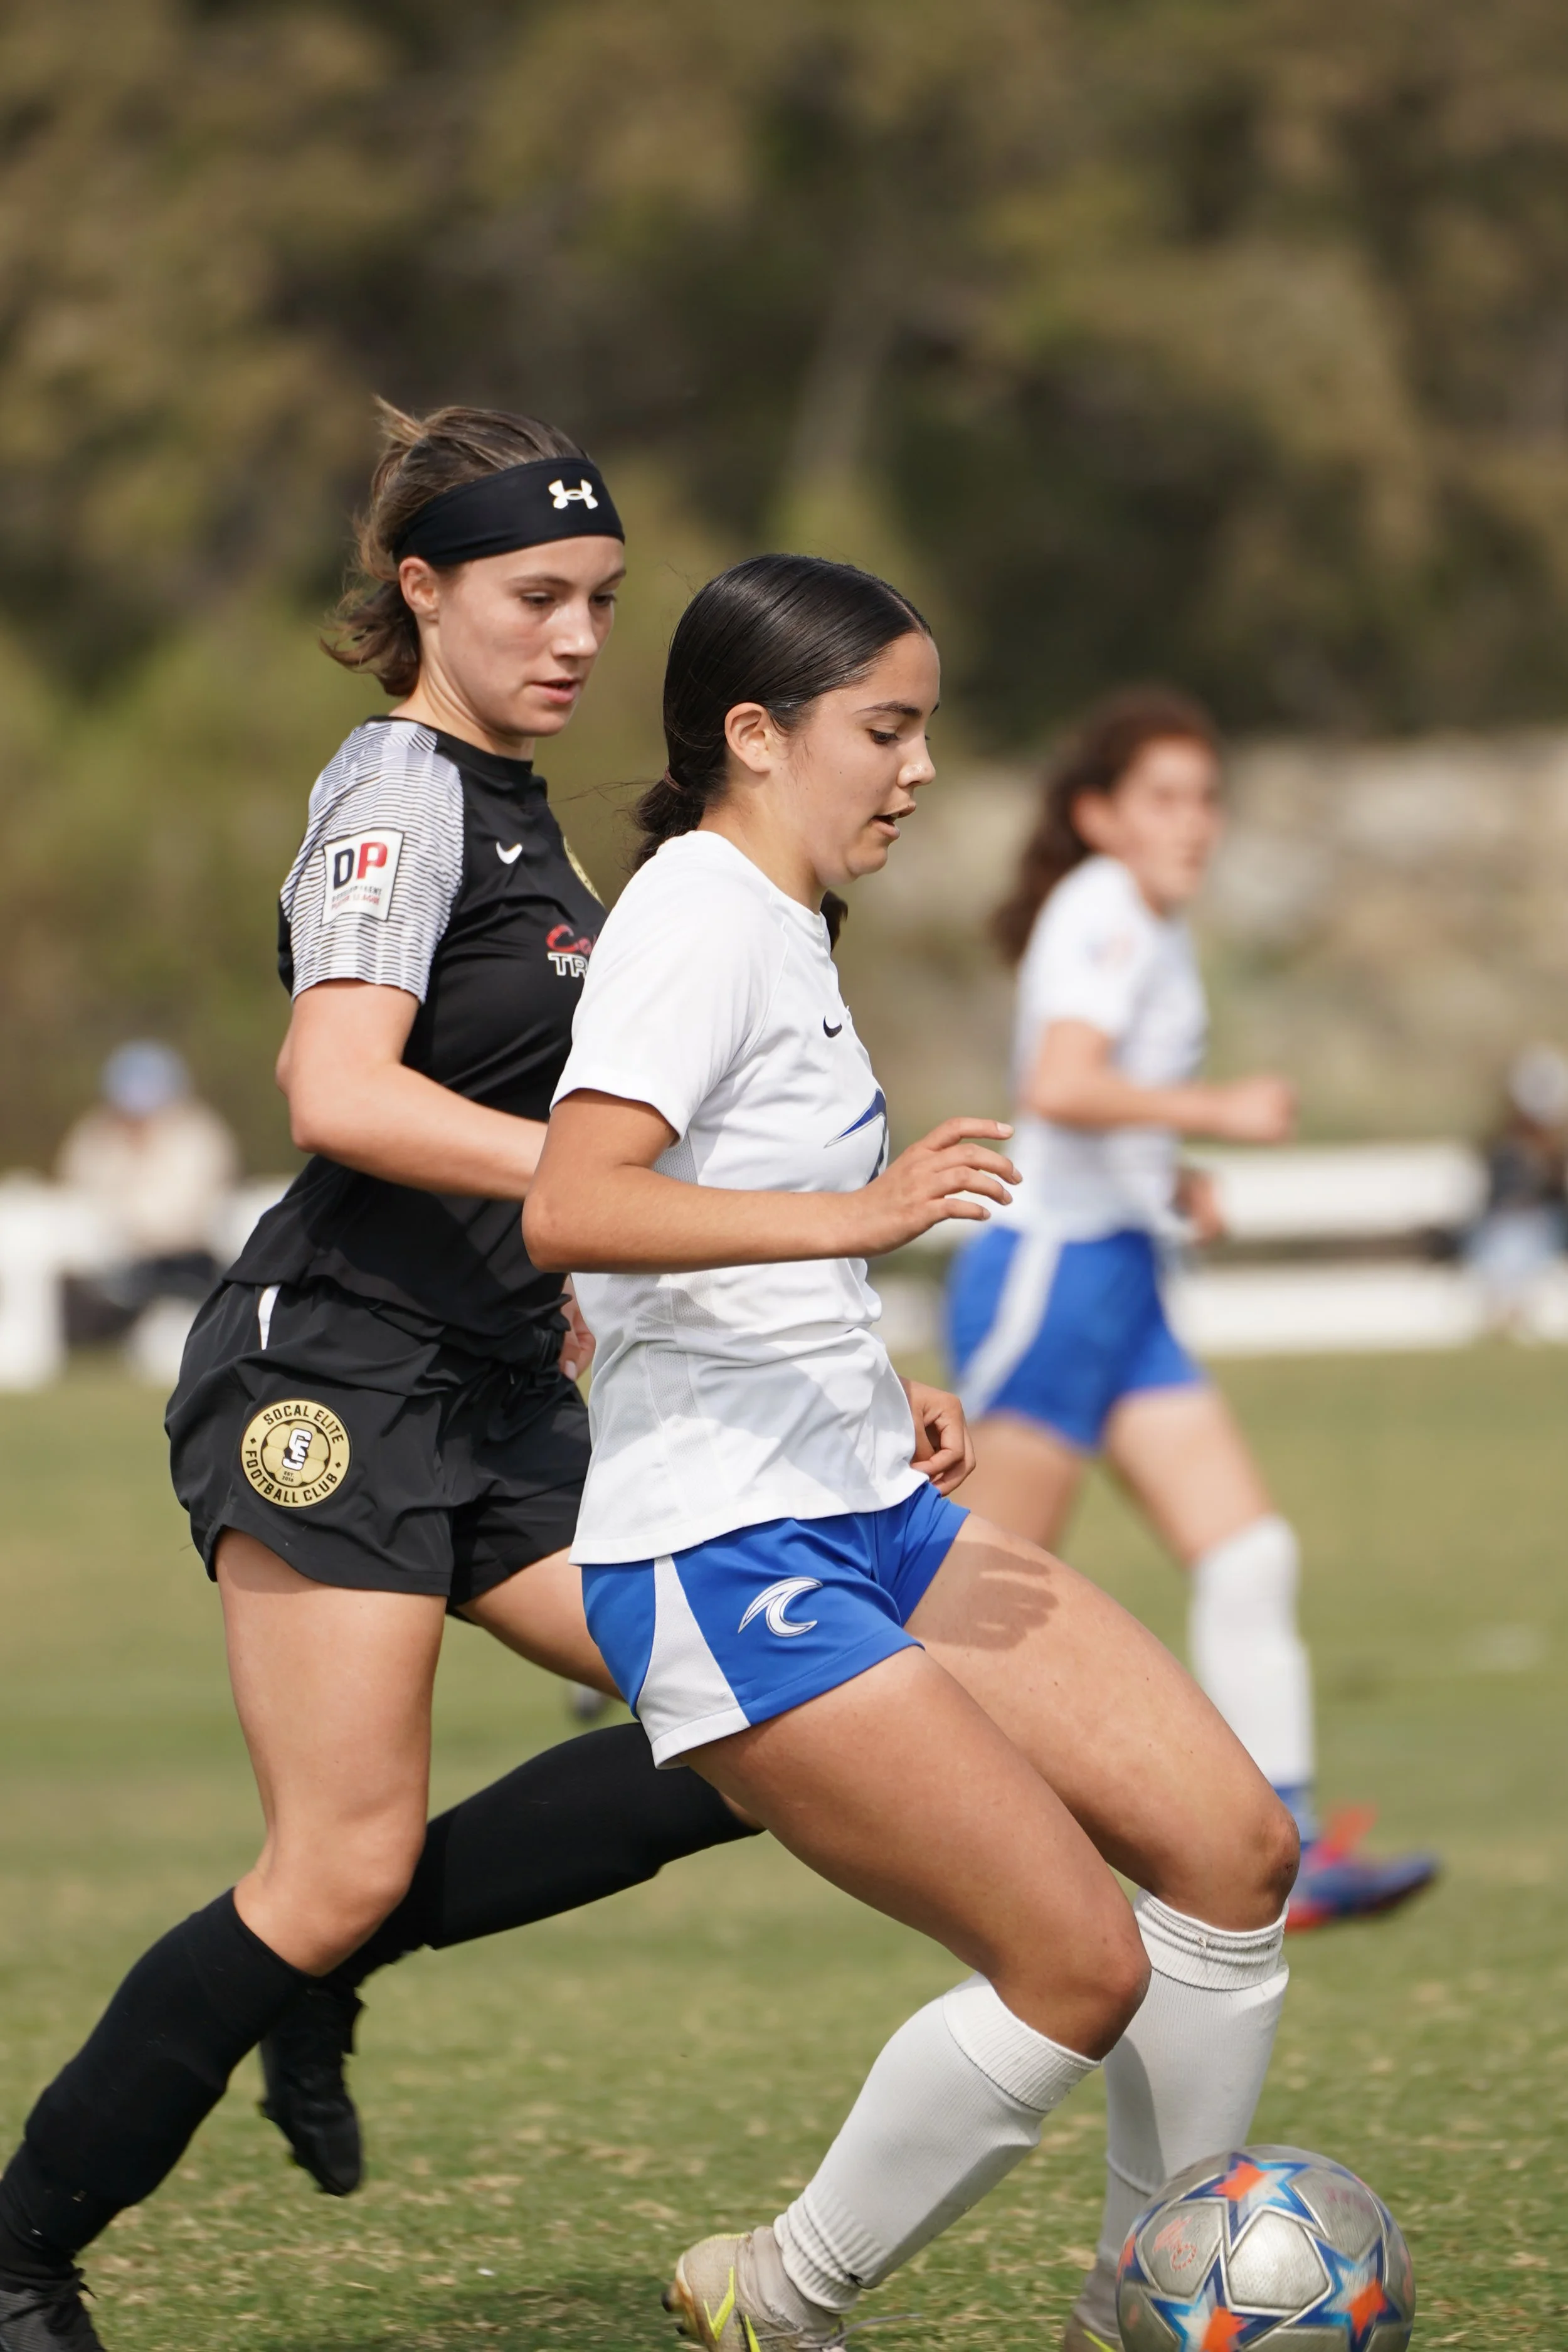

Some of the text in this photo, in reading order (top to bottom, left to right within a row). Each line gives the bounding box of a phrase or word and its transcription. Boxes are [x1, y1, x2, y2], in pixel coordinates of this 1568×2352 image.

[334, 842, 388, 889] DP
[547, 924, 596, 954] Ca
[263, 1405, 344, 1444] SOCAL ELITE
[245, 1451, 337, 1503] FOOTBALL CLUB
